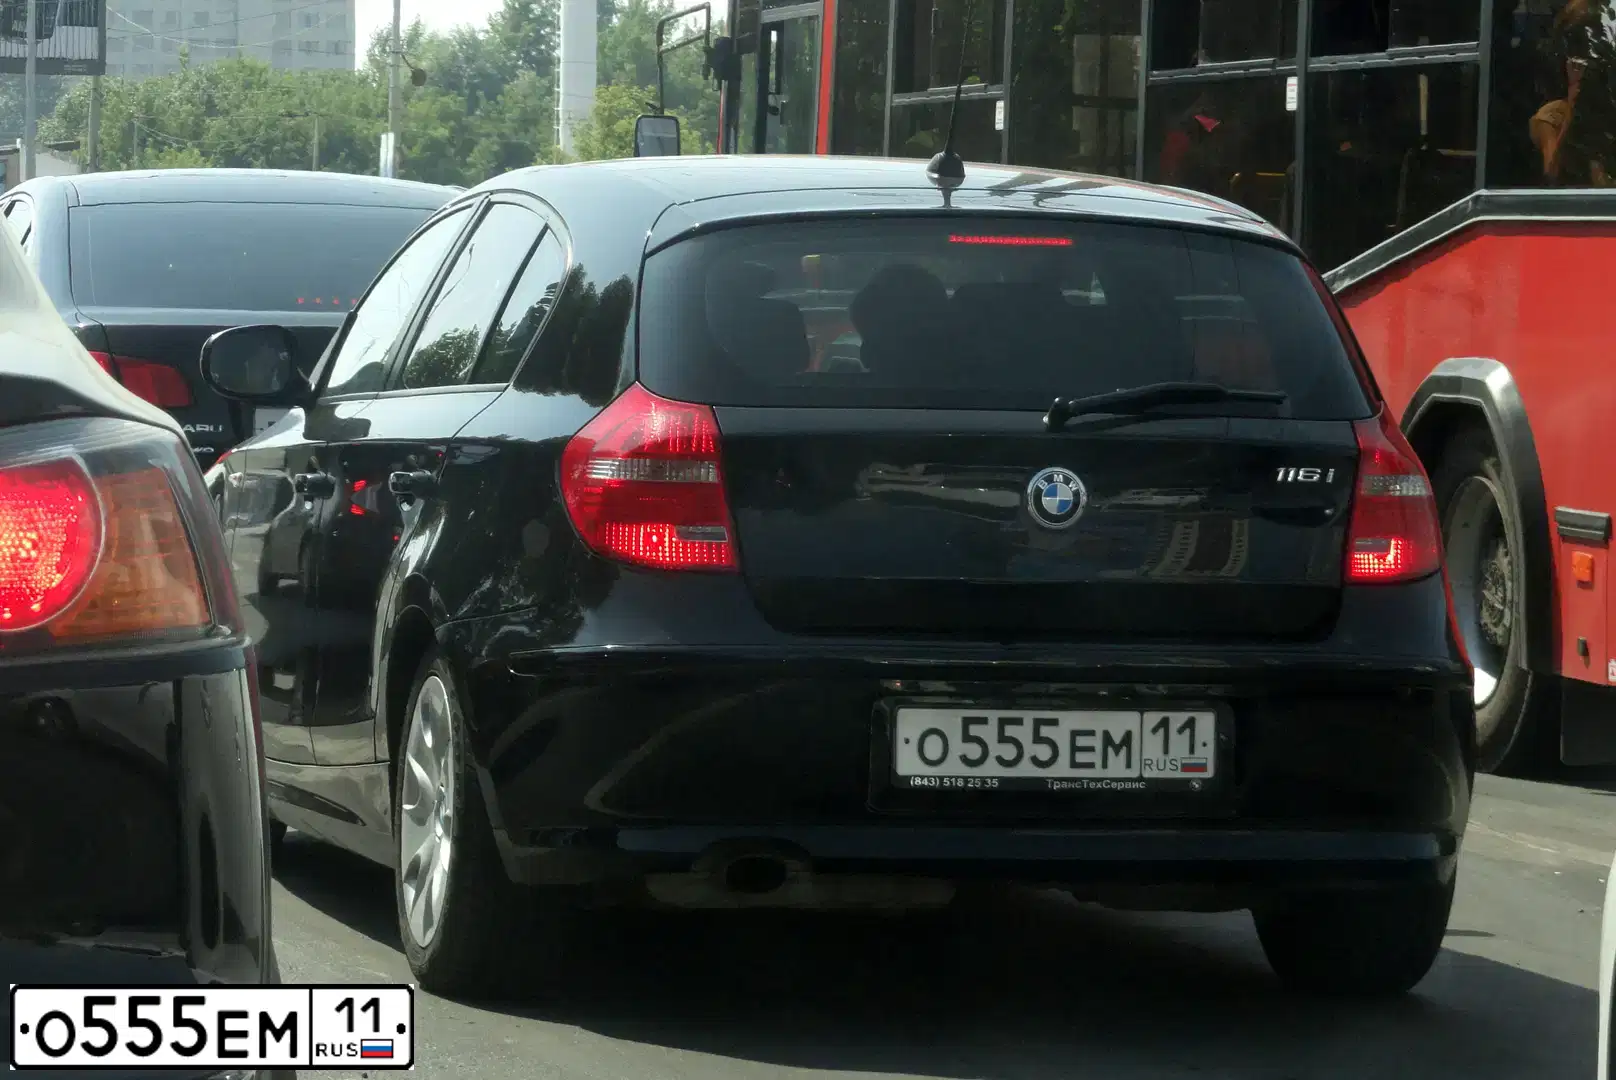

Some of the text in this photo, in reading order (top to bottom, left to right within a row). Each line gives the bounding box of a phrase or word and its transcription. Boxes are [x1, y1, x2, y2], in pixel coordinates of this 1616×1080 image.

[1276, 467, 1335, 483] 116i
[1037, 474, 1080, 492] BMW
[1150, 715, 1196, 755] 11
[1143, 757, 1179, 772] RUS
[910, 776, 999, 788] (843) 518 25 35
[1046, 779, 1146, 790] ТрансТехСервис
